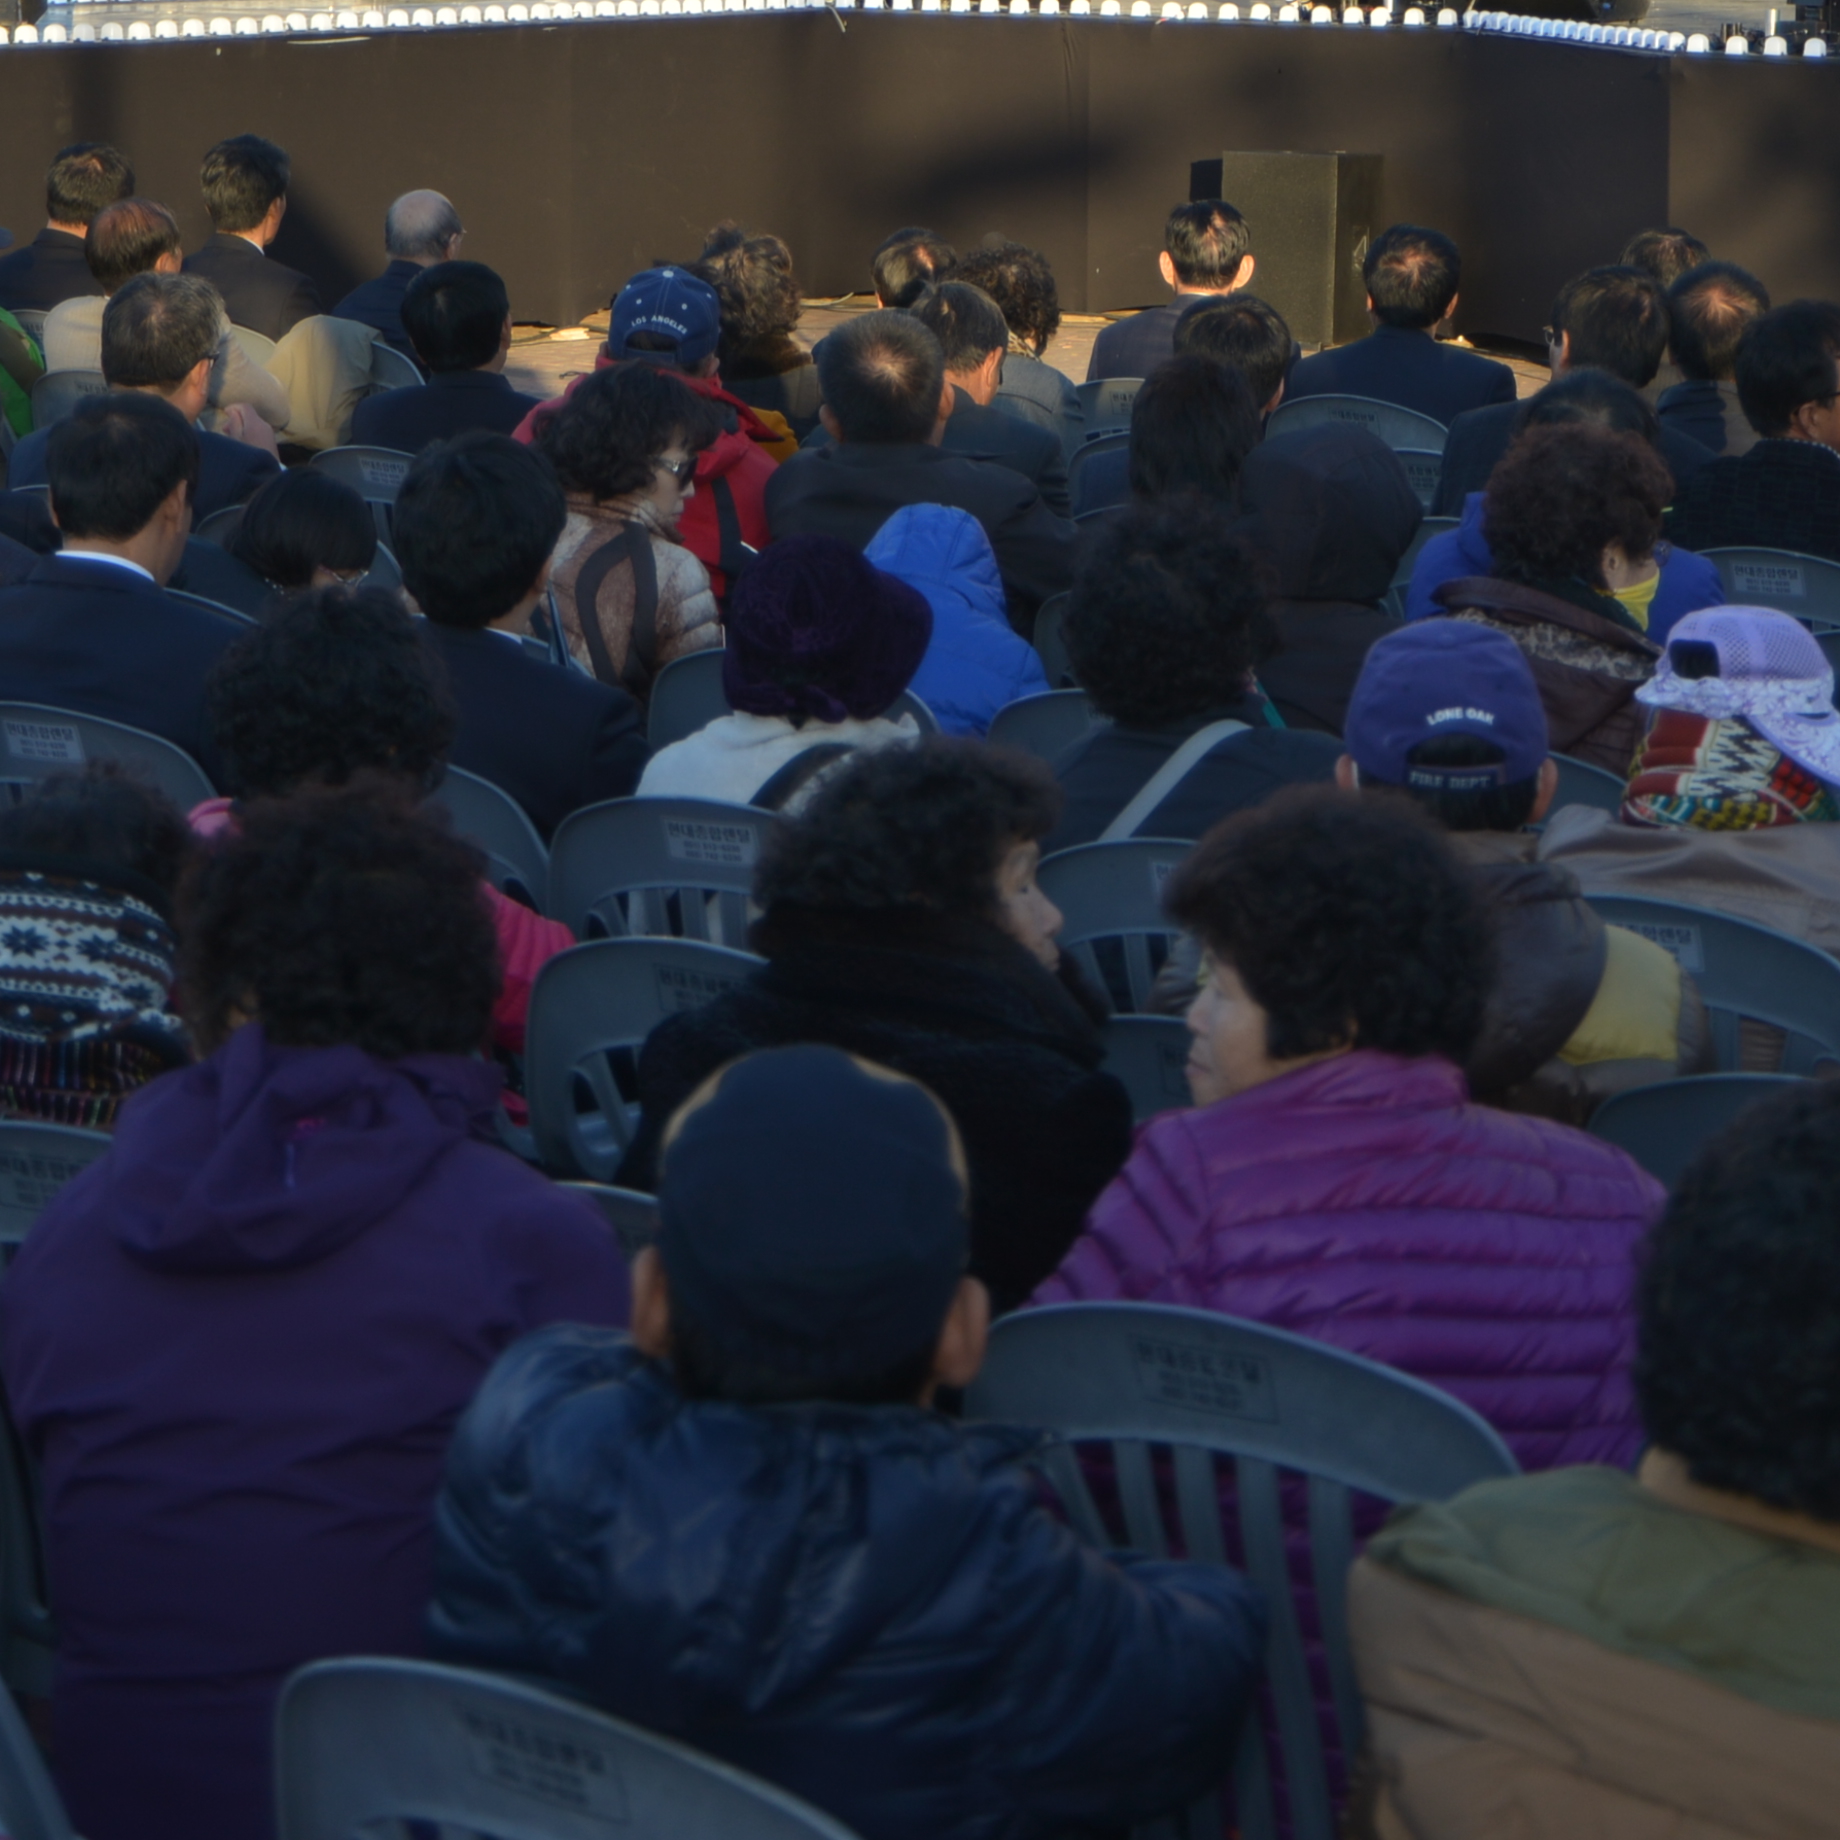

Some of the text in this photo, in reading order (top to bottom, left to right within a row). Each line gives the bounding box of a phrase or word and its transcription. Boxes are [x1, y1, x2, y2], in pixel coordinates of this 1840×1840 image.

[631, 315, 688, 335] LOS ANGELES
[1426, 707, 1495, 726] LONE OAK
[1410, 771, 1443, 788] FIRE
